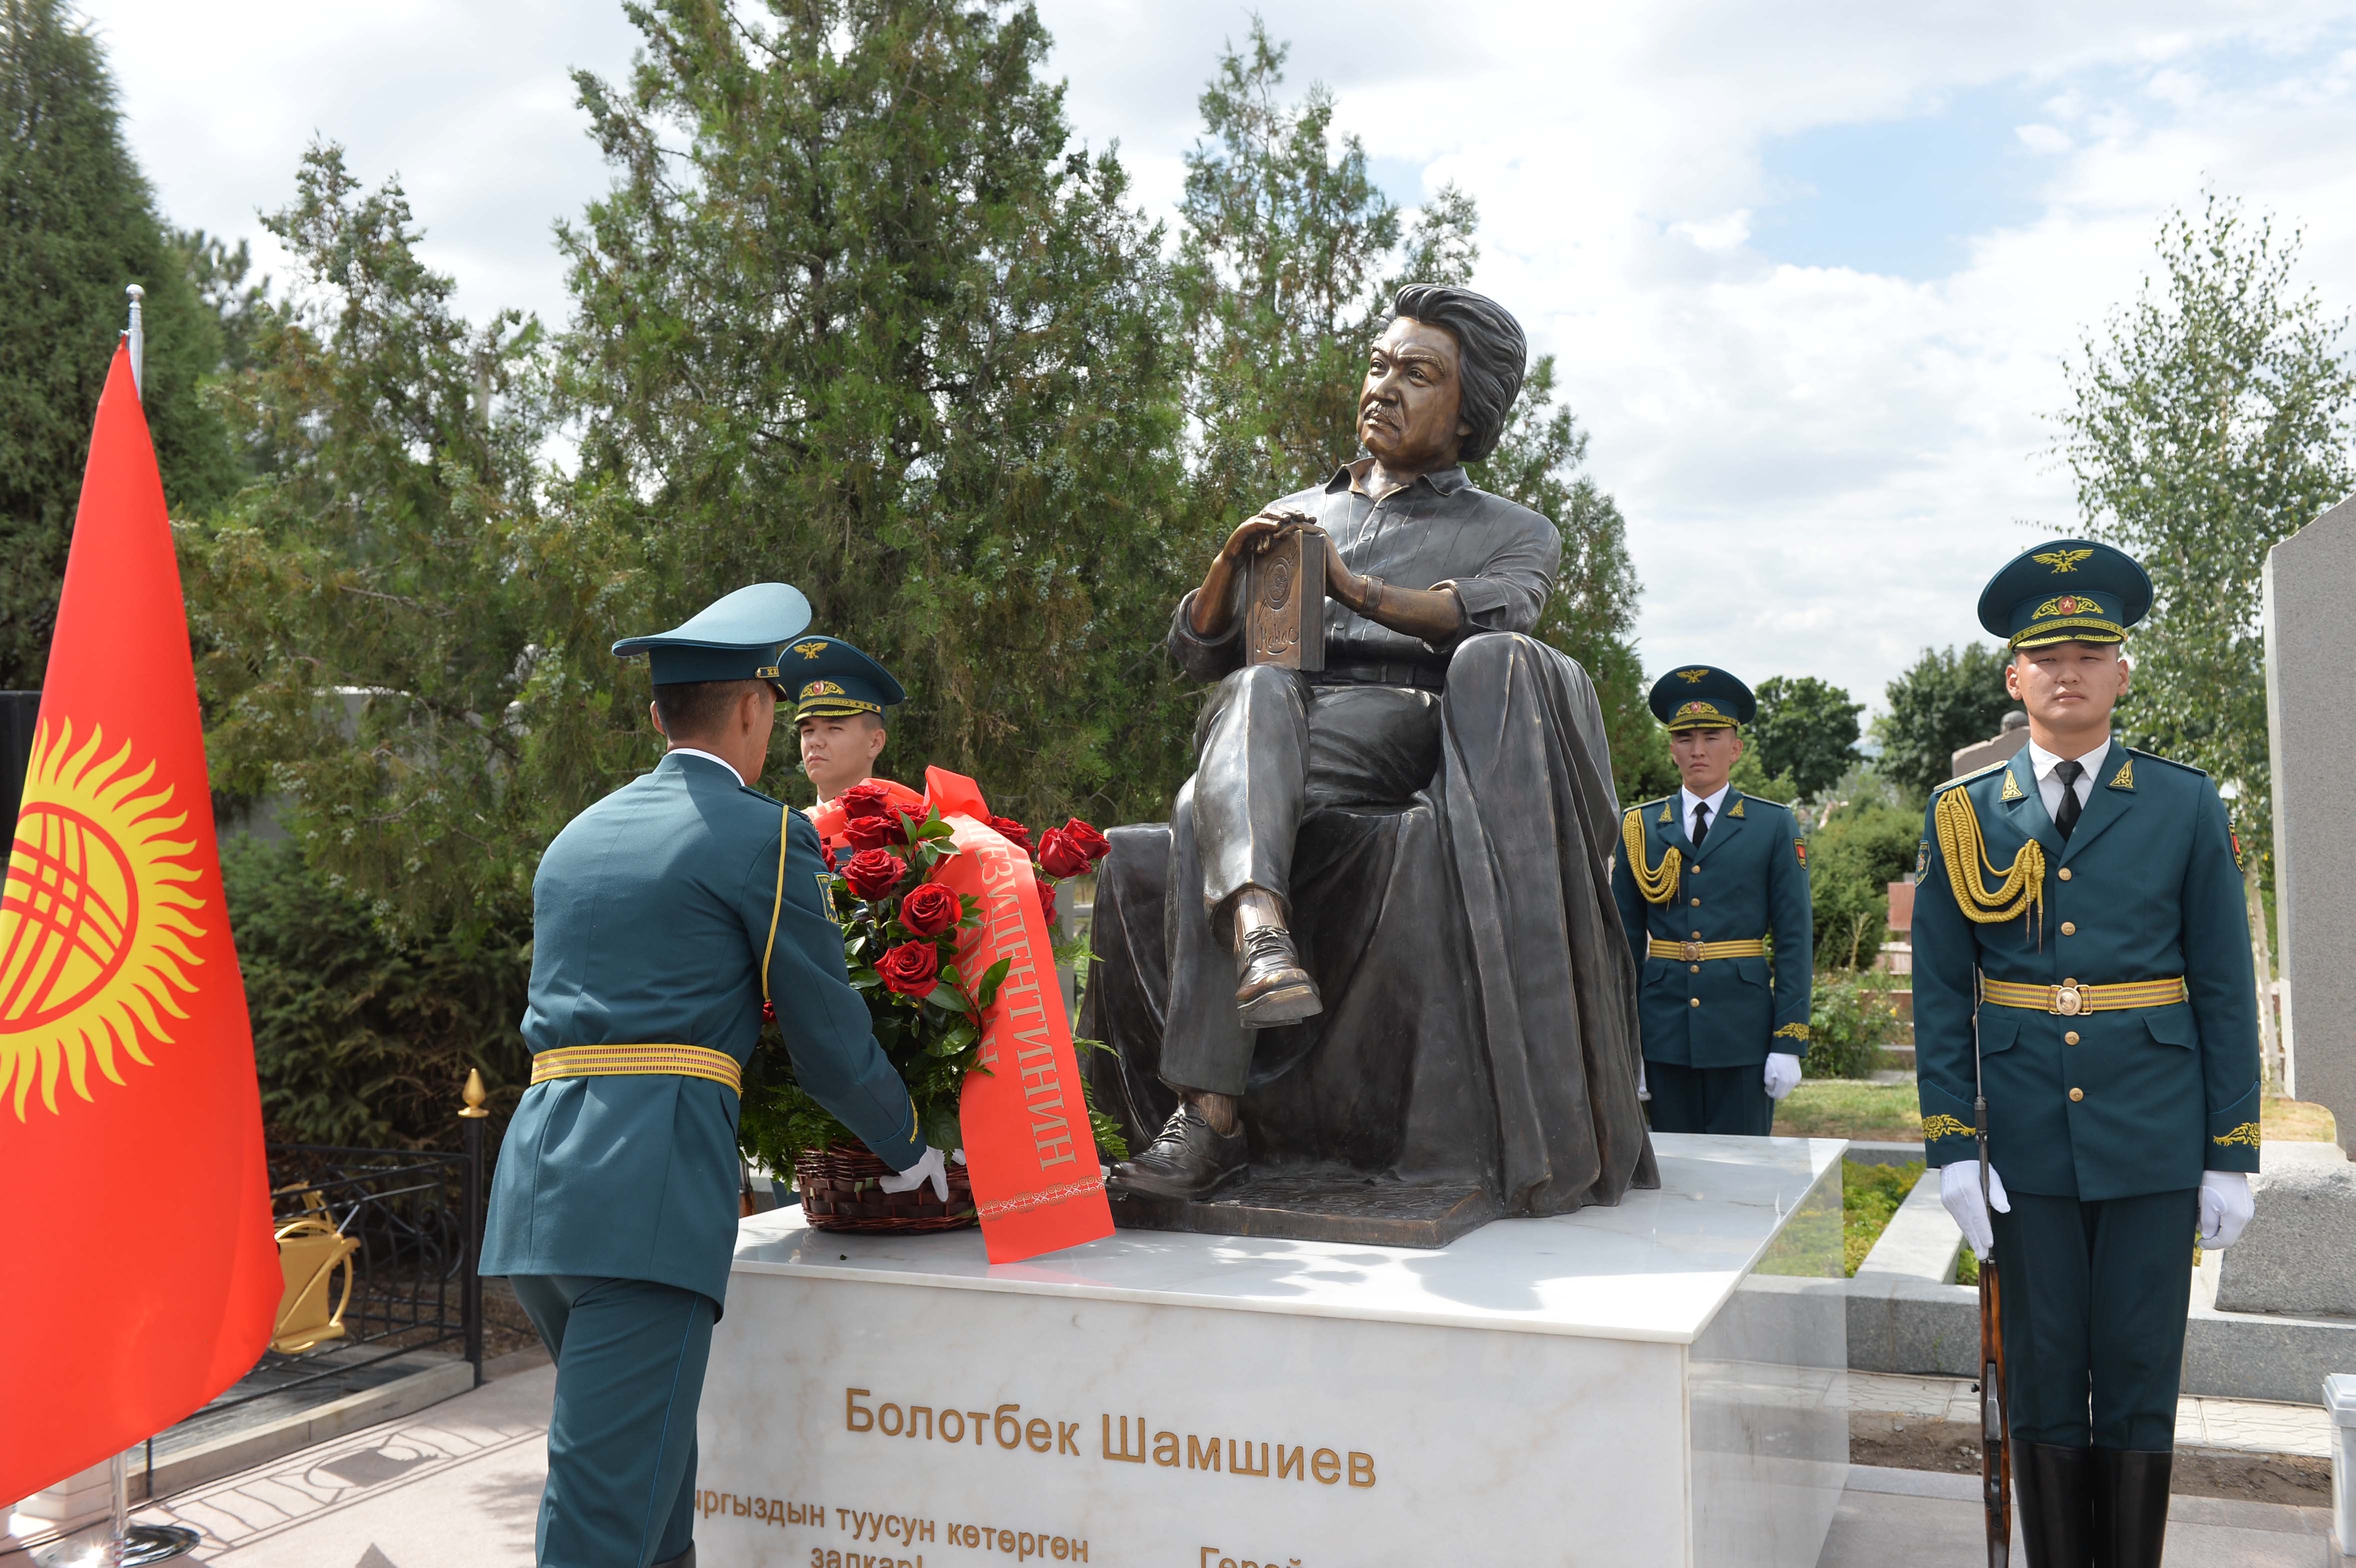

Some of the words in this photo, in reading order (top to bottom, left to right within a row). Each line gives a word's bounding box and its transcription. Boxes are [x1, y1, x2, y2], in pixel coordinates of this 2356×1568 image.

[846, 1388, 1080, 1457] Болотбек
[1102, 1414, 1376, 1489] Шамшиев
[836, 1508, 935, 1547] туусун
[948, 1523, 1088, 1563] көтөргөн
